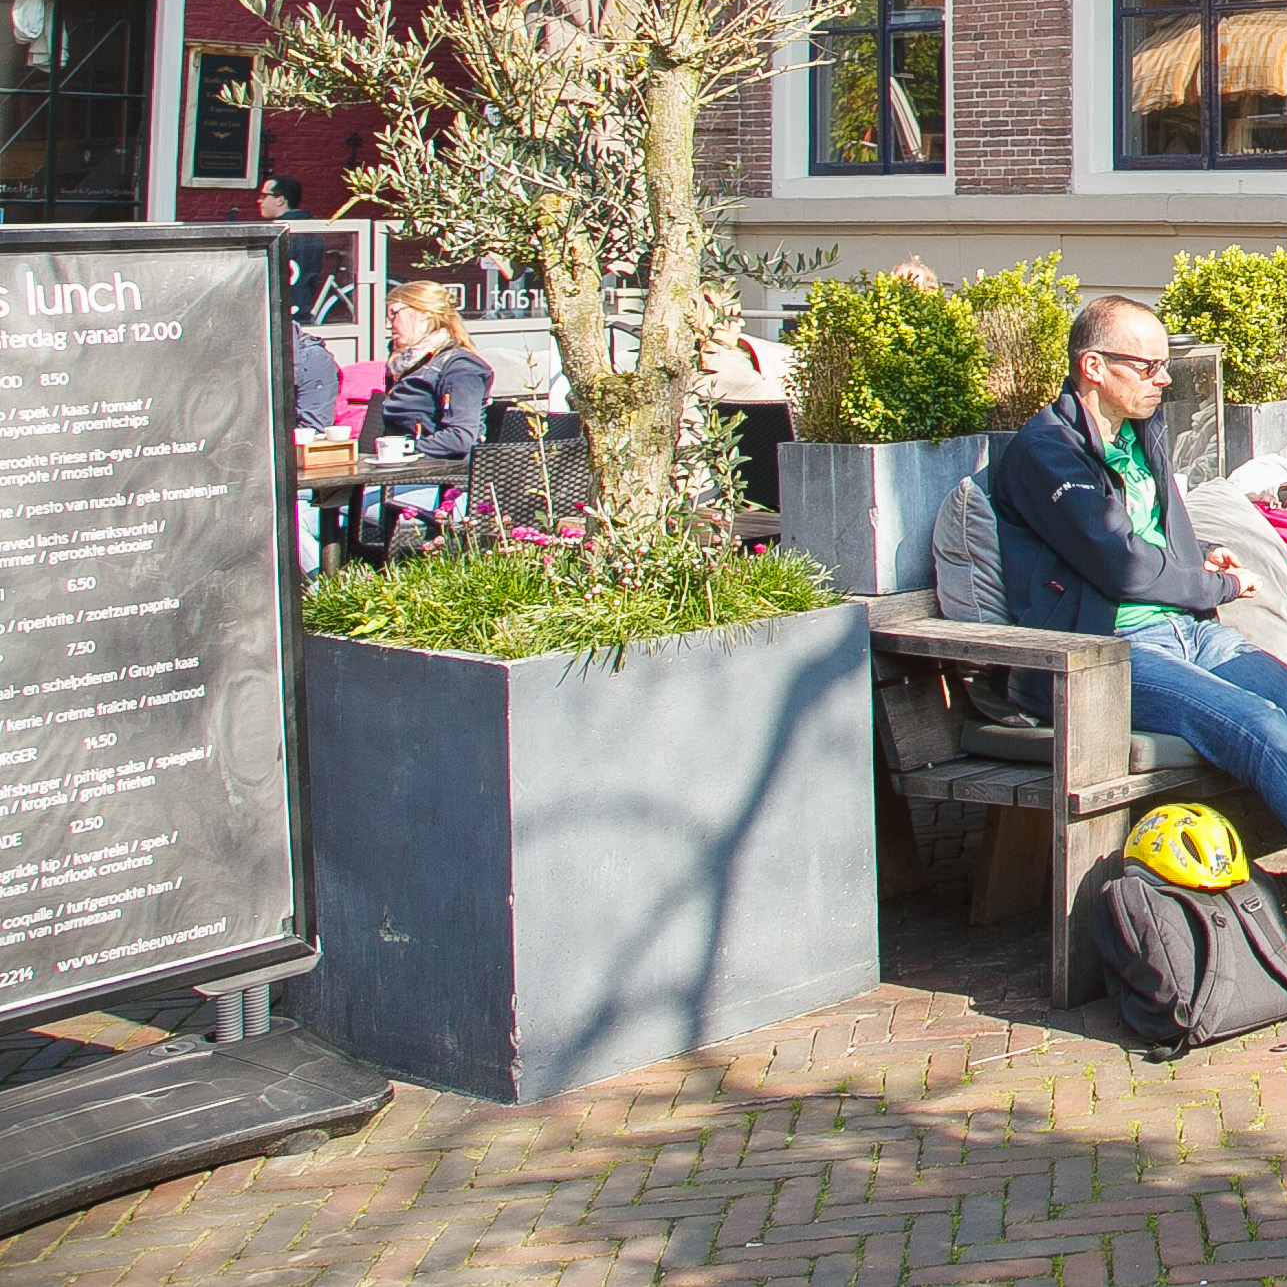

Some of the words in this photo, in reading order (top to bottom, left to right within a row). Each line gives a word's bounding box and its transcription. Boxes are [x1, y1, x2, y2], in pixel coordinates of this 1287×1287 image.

[25, 270, 142, 316] lunch
[0, 328, 67, 351] terdag
[72, 324, 126, 346] vanaf
[129, 321, 183, 342] 12.00
[0, 374, 23, 389] OD
[39, 372, 70, 387] 8.50
[18, 406, 50, 422] spek
[61, 403, 89, 417] kaas
[101, 399, 143, 414] tomaat
[72, 414, 150, 435] groentechips
[50, 450, 87, 465] Friese
[89, 448, 133, 463] rib-eye
[142, 442, 171, 457] oude
[172, 440, 198, 454] kaas
[61, 463, 114, 481] mosterd
[25, 501, 64, 519] pesto
[65, 498, 88, 512] van
[89, 492, 126, 509] rucola
[135, 489, 161, 508] gele
[161, 483, 228, 501] tomatenjam
[37, 532, 70, 548] lachs
[80, 520, 158, 542] mierikswortel
[48, 544, 105, 565] gerookte
[107, 538, 154, 556] eidooier
[65, 576, 97, 593] 6.50
[85, 603, 139, 622] zoetzure
[139, 597, 181, 617] paprika
[66, 640, 97, 657] 7.50
[22, 684, 39, 696] en
[41, 669, 118, 695] schelpdieren
[128, 658, 174, 679] Gruyère
[174, 655, 200, 670] kaas
[6, 714, 43, 732] kerrie
[54, 703, 95, 724] crème
[96, 696, 138, 716] fraîche
[147, 684, 206, 707] naanbrood
[0, 747, 38, 766] RGER
[83, 732, 118, 750] 14.50
[72, 765, 116, 787] pittige
[116, 760, 146, 776] salsa
[155, 745, 205, 770] spiegelei
[21, 791, 68, 813] kropsla
[78, 782, 116, 803] grote
[116, 774, 156, 793] frieten
[69, 815, 104, 834] 12.50
[40, 857, 61, 874] kip
[73, 841, 129, 866] kwartelei
[139, 833, 170, 852] spek
[40, 866, 97, 890] knoflook
[98, 853, 154, 877] croutons
[2, 906, 54, 930] coquille
[66, 885, 146, 914] turfgerookte
[147, 878, 174, 896] ham
[27, 924, 53, 941] van
[53, 906, 123, 936] parmezaan
[56, 916, 227, 974] www.semsleeuwarden.nl
